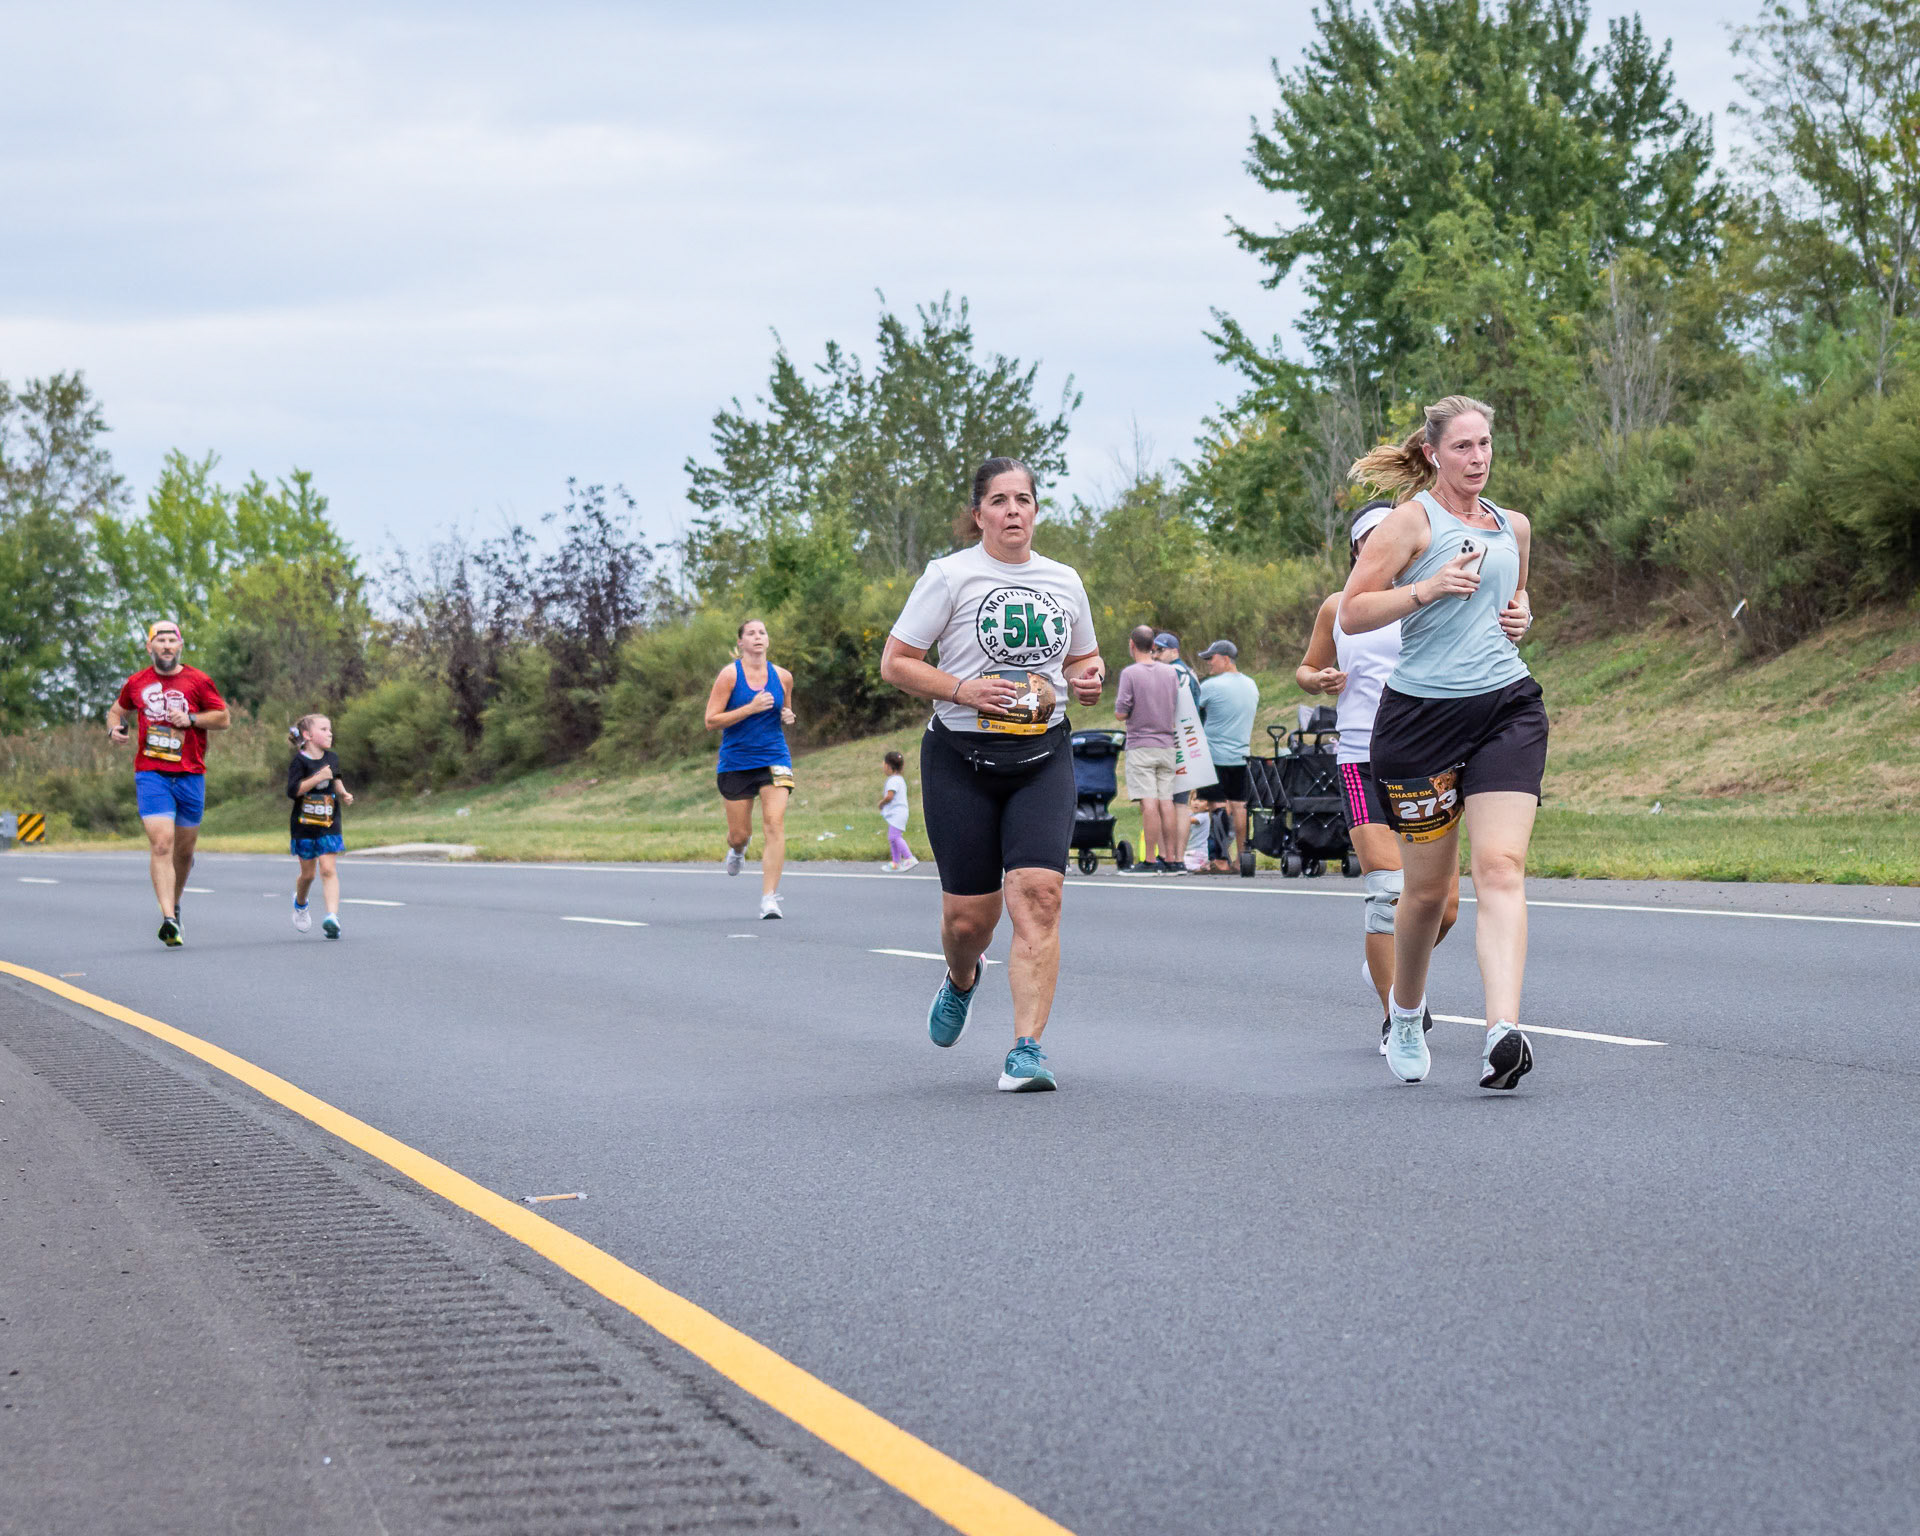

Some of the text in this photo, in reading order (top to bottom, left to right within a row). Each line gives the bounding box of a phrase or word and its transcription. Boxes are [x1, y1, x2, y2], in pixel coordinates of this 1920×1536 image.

[985, 591, 1059, 614] Morristown
[985, 635, 998, 652] St.
[1042, 637, 1062, 658] Day
[1181, 717, 1202, 761] RUN!
[1398, 788, 1458, 819] 273
